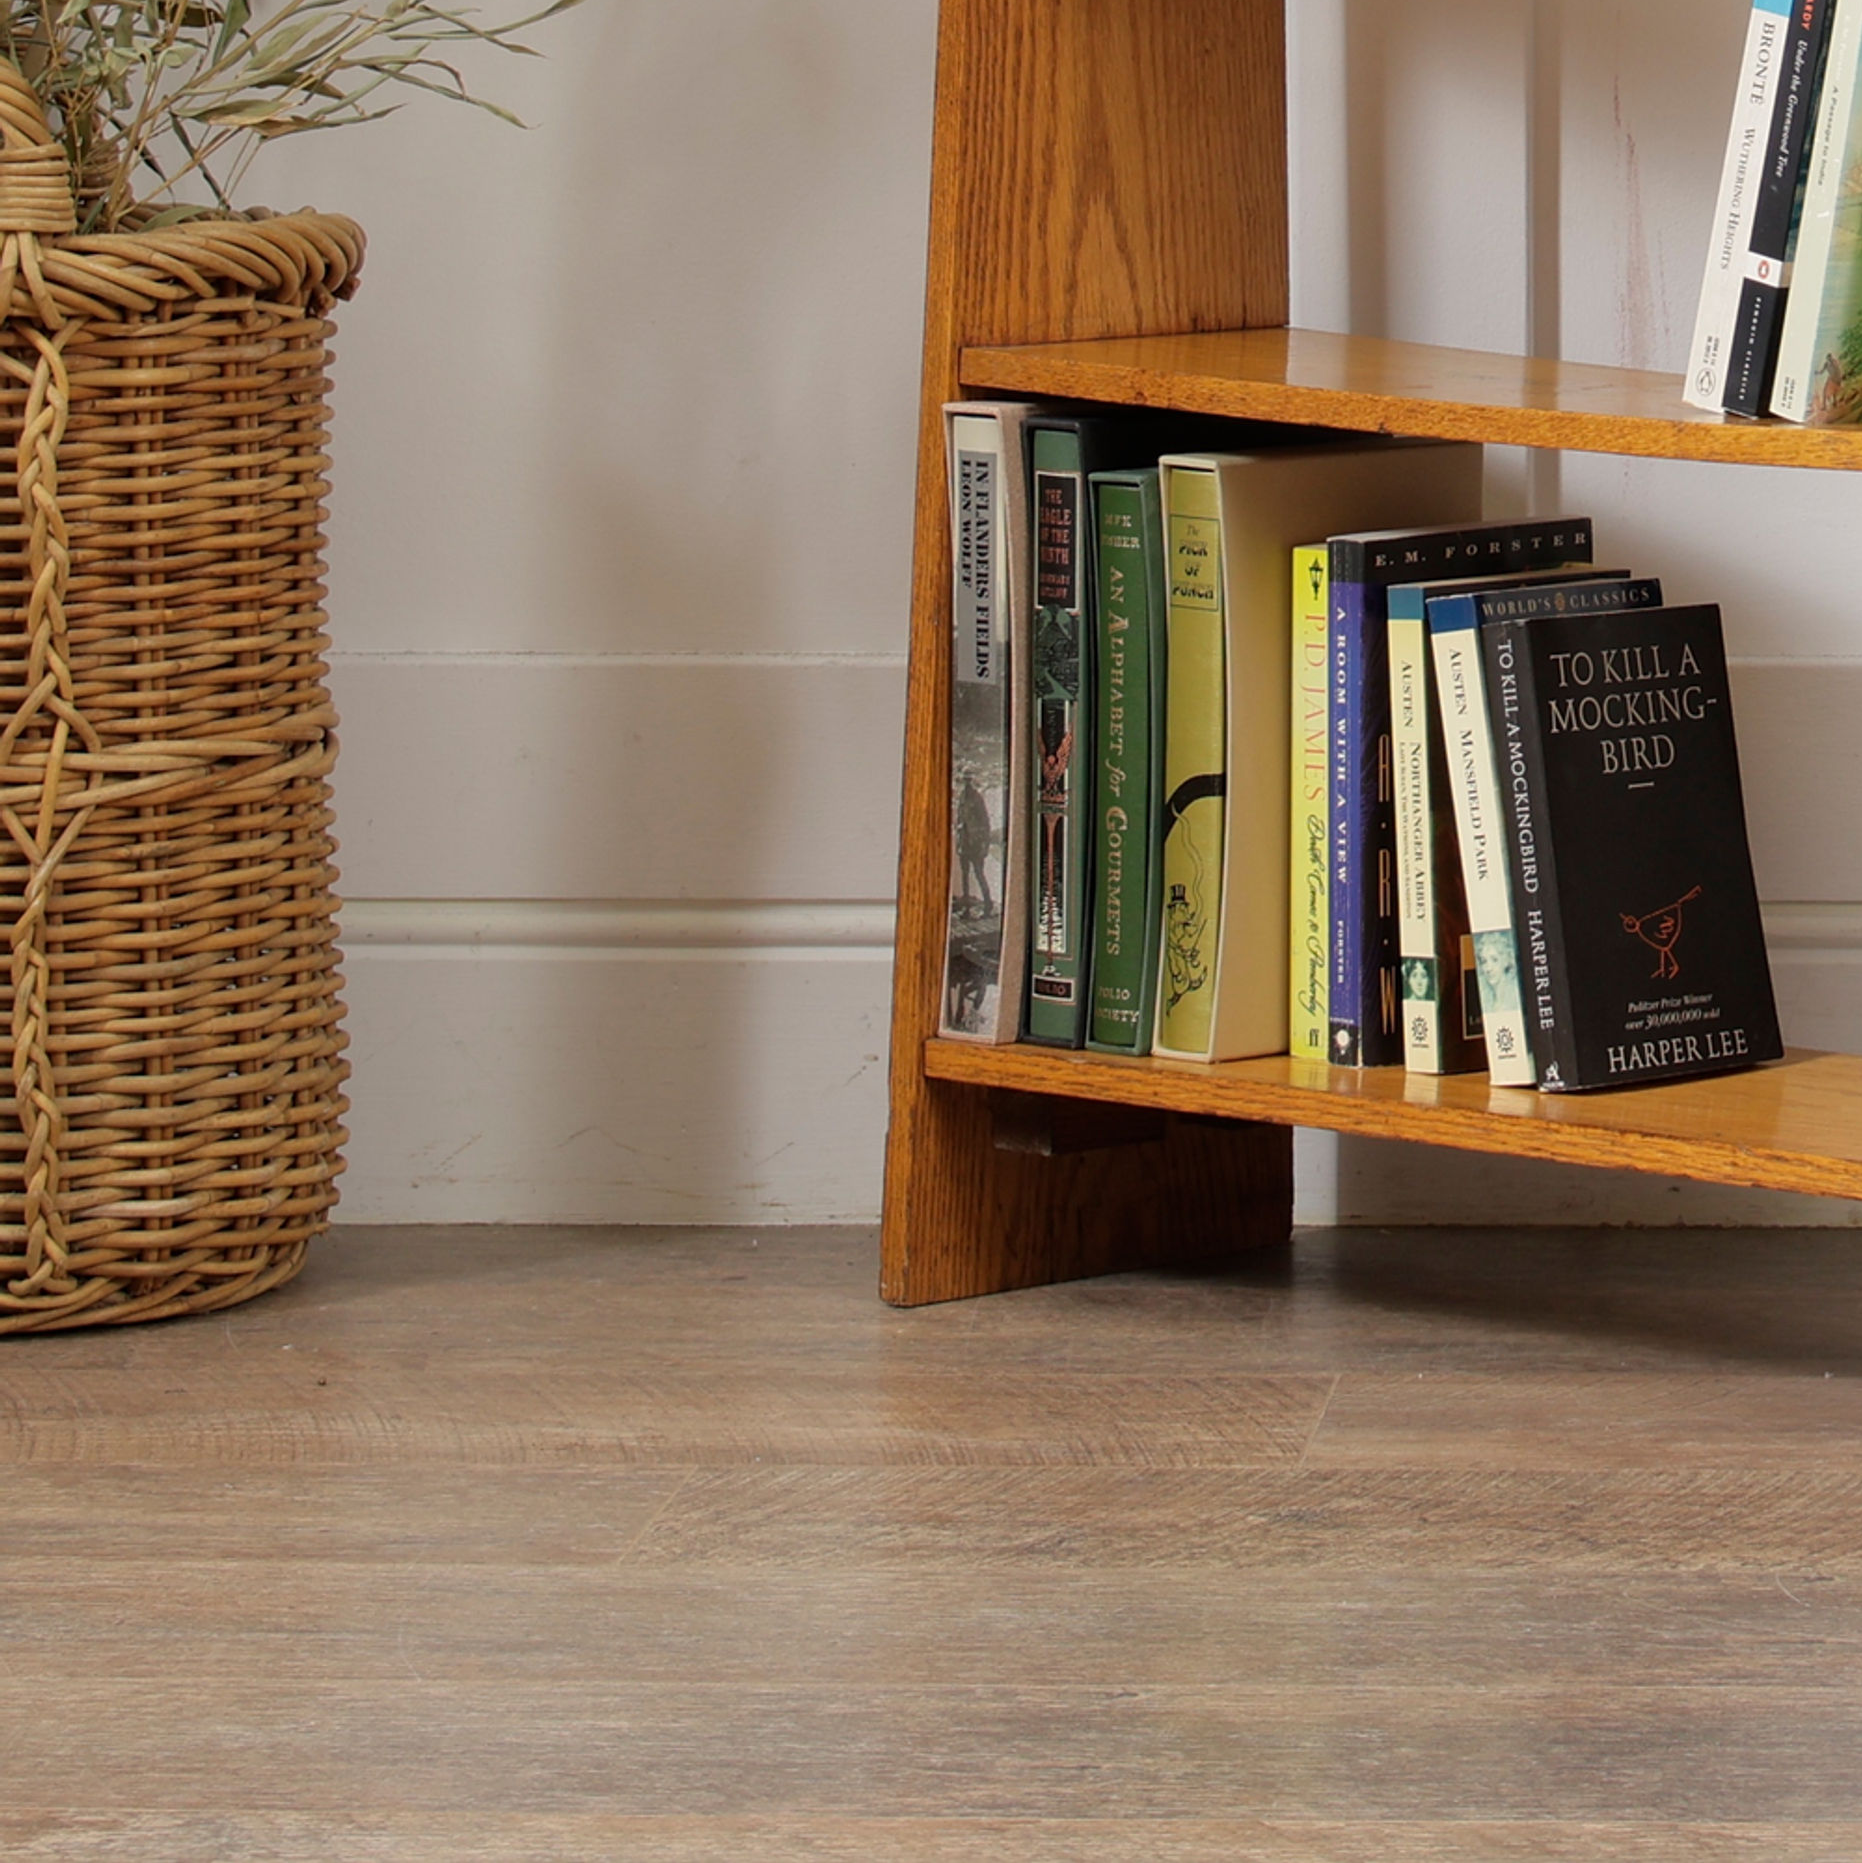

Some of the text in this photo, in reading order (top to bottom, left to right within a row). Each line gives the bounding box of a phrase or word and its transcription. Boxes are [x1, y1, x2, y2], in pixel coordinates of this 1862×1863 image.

[1774, 39, 1808, 178] Under the Greenwood Tree
[1716, 127, 1758, 270] WUTHERING HEIGHTS
[960, 459, 971, 587] LEON WOLFF
[974, 460, 989, 678] IN FLANDERS FIELDS
[1375, 533, 1585, 567] E. M. FORSTER
[1482, 588, 1650, 616] WORLD'S CLASSICS
[1399, 659, 1415, 727] AUSTEN
[1448, 648, 1469, 715] AUSTEN
[1550, 643, 1700, 687] TO KILL A
[1550, 687, 1717, 733] MOCKING-
[1104, 566, 1128, 955] AN ALPHABET for GOURMETS
[1298, 685, 1327, 801] JAMES
[1336, 607, 1346, 884] A ROOM WITH A VIEW
[1496, 639, 1539, 894] TO KILL A MOCKINGBIRD
[1601, 735, 1675, 774] BIRD
[1409, 742, 1427, 922] NORTHANGER ABBEY
[1459, 729, 1490, 880] MANSFIELD PARK
[1527, 909, 1554, 1030] HARPER LEE
[1625, 1007, 1720, 1030] over 30,000,000 sold
[1628, 994, 1713, 1013] Pulitzer Prize Winner
[1607, 1029, 1748, 1073] HARPER LEE
